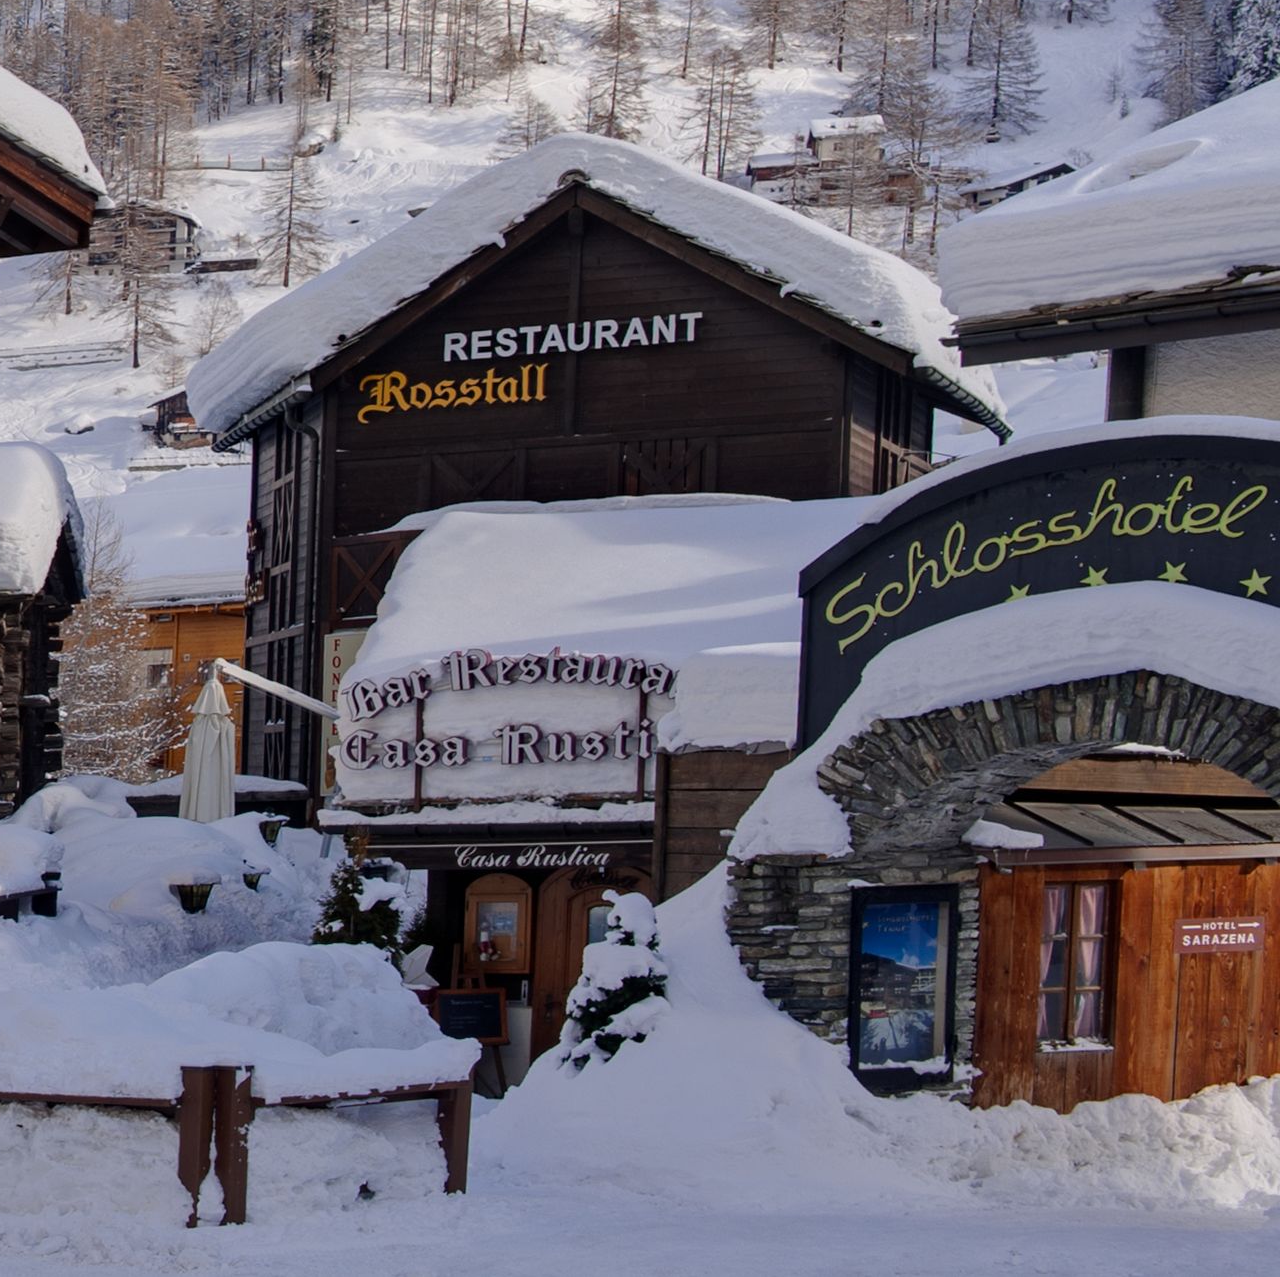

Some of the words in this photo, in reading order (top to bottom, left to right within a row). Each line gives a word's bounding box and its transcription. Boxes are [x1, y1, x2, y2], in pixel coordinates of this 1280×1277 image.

[443, 312, 703, 362] RESTAURANT
[357, 363, 550, 424] Rosstall
[825, 475, 1268, 654] Schlosshotel
[341, 668, 431, 722] Bar
[340, 728, 470, 770] Casa
[454, 844, 511, 868] Casa
[516, 844, 611, 867] Rustica
[1182, 933, 1256, 946] SARAZENA
[1202, 922, 1237, 931] HOTEL
